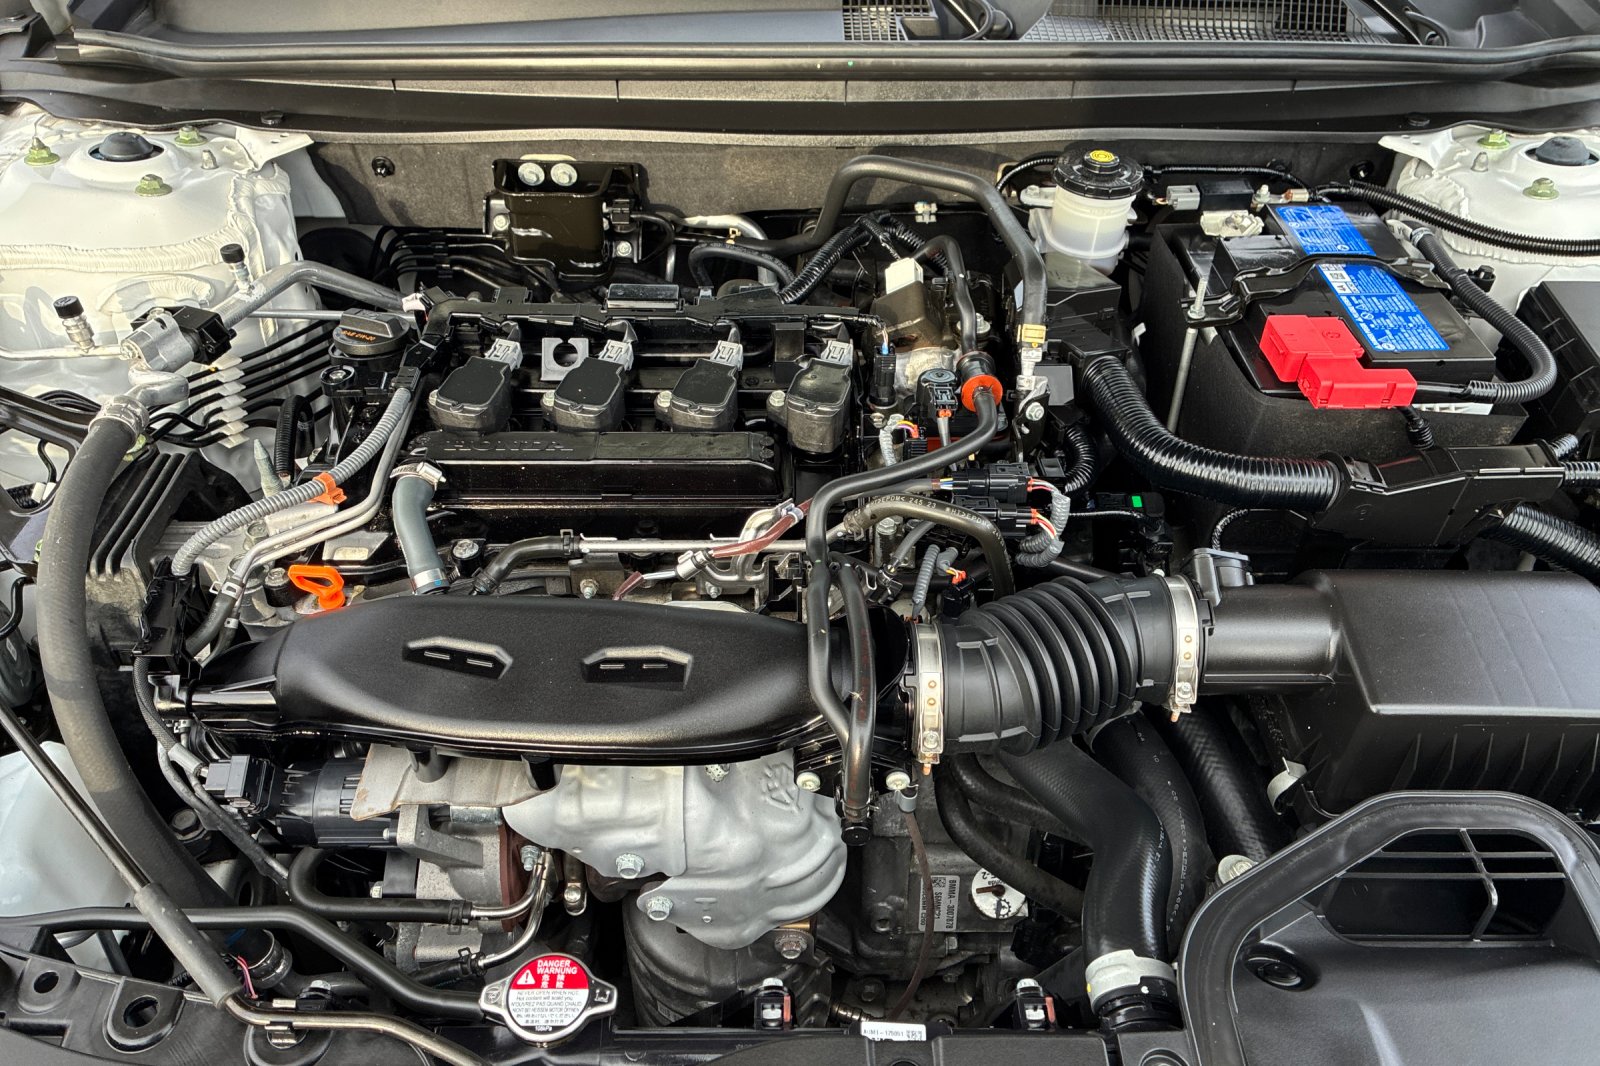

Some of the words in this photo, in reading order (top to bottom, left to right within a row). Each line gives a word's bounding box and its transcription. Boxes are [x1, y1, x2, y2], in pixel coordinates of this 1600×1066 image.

[443, 440, 574, 451] HONDA
[908, 497, 923, 506] 245
[927, 501, 937, 509] 23
[537, 959, 571, 967] DANGER
[536, 967, 578, 975] WARNUNG
